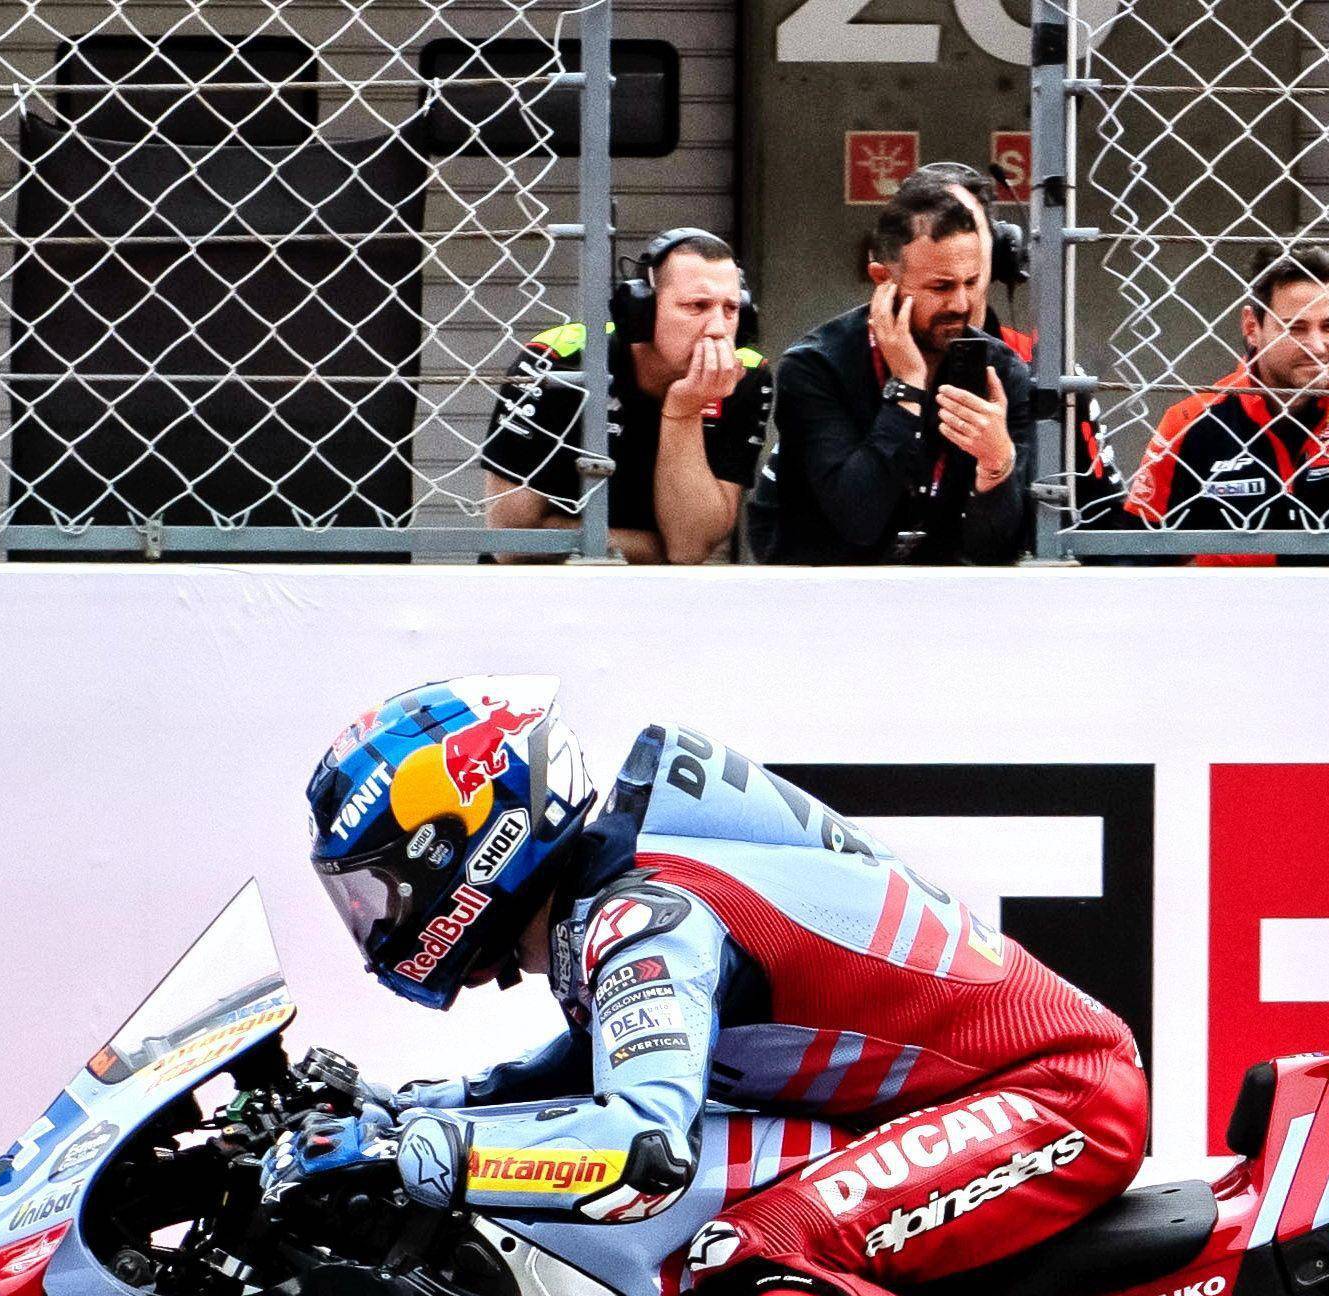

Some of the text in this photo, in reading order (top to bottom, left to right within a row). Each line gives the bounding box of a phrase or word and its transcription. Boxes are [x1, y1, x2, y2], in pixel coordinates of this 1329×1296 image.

[473, 817, 524, 877] SHOEI
[595, 966, 634, 1001] BOLD
[628, 1038, 686, 1052] VERTICAL
[466, 1150, 608, 1189] Antangin
[813, 1092, 1039, 1217] DUCATI
[865, 1130, 1087, 1258] alpinestars
